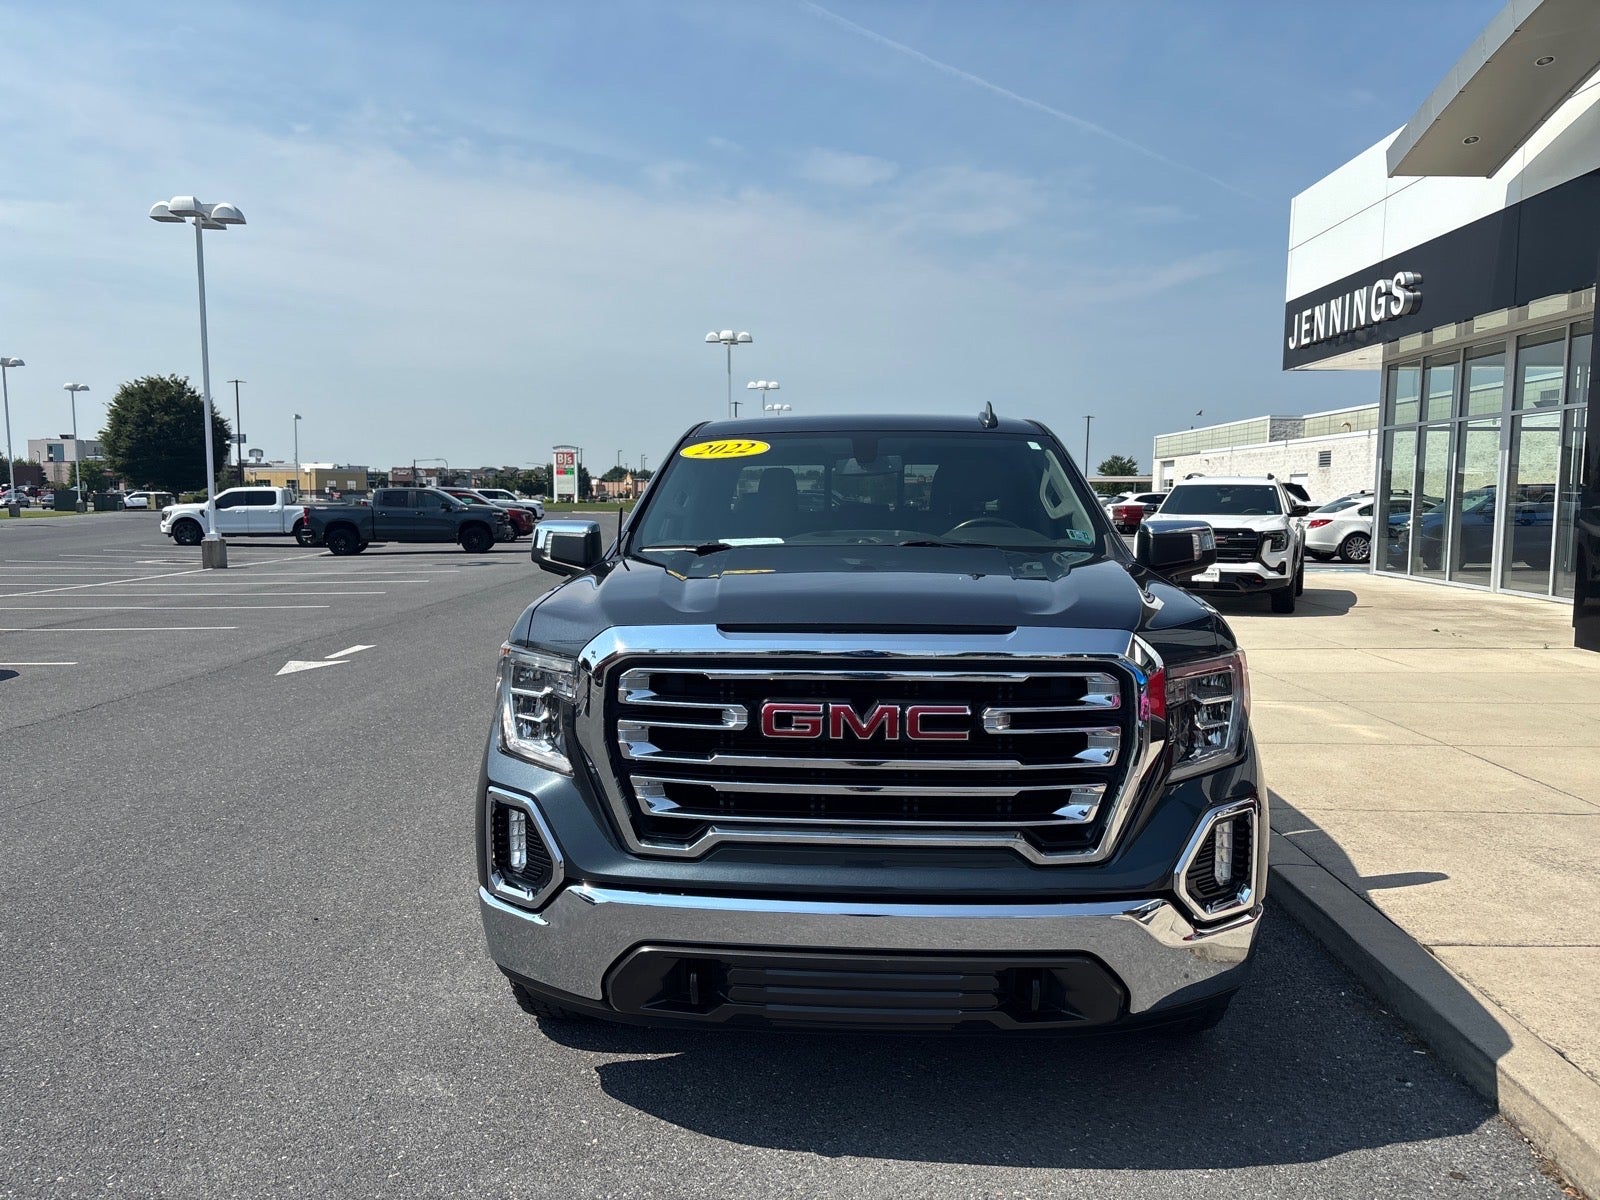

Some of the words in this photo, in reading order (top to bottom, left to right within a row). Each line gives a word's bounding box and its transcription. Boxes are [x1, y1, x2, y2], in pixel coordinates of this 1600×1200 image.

[1288, 271, 1415, 350] JENNINGS
[693, 443, 757, 456] 2022
[761, 702, 971, 741] GMC
